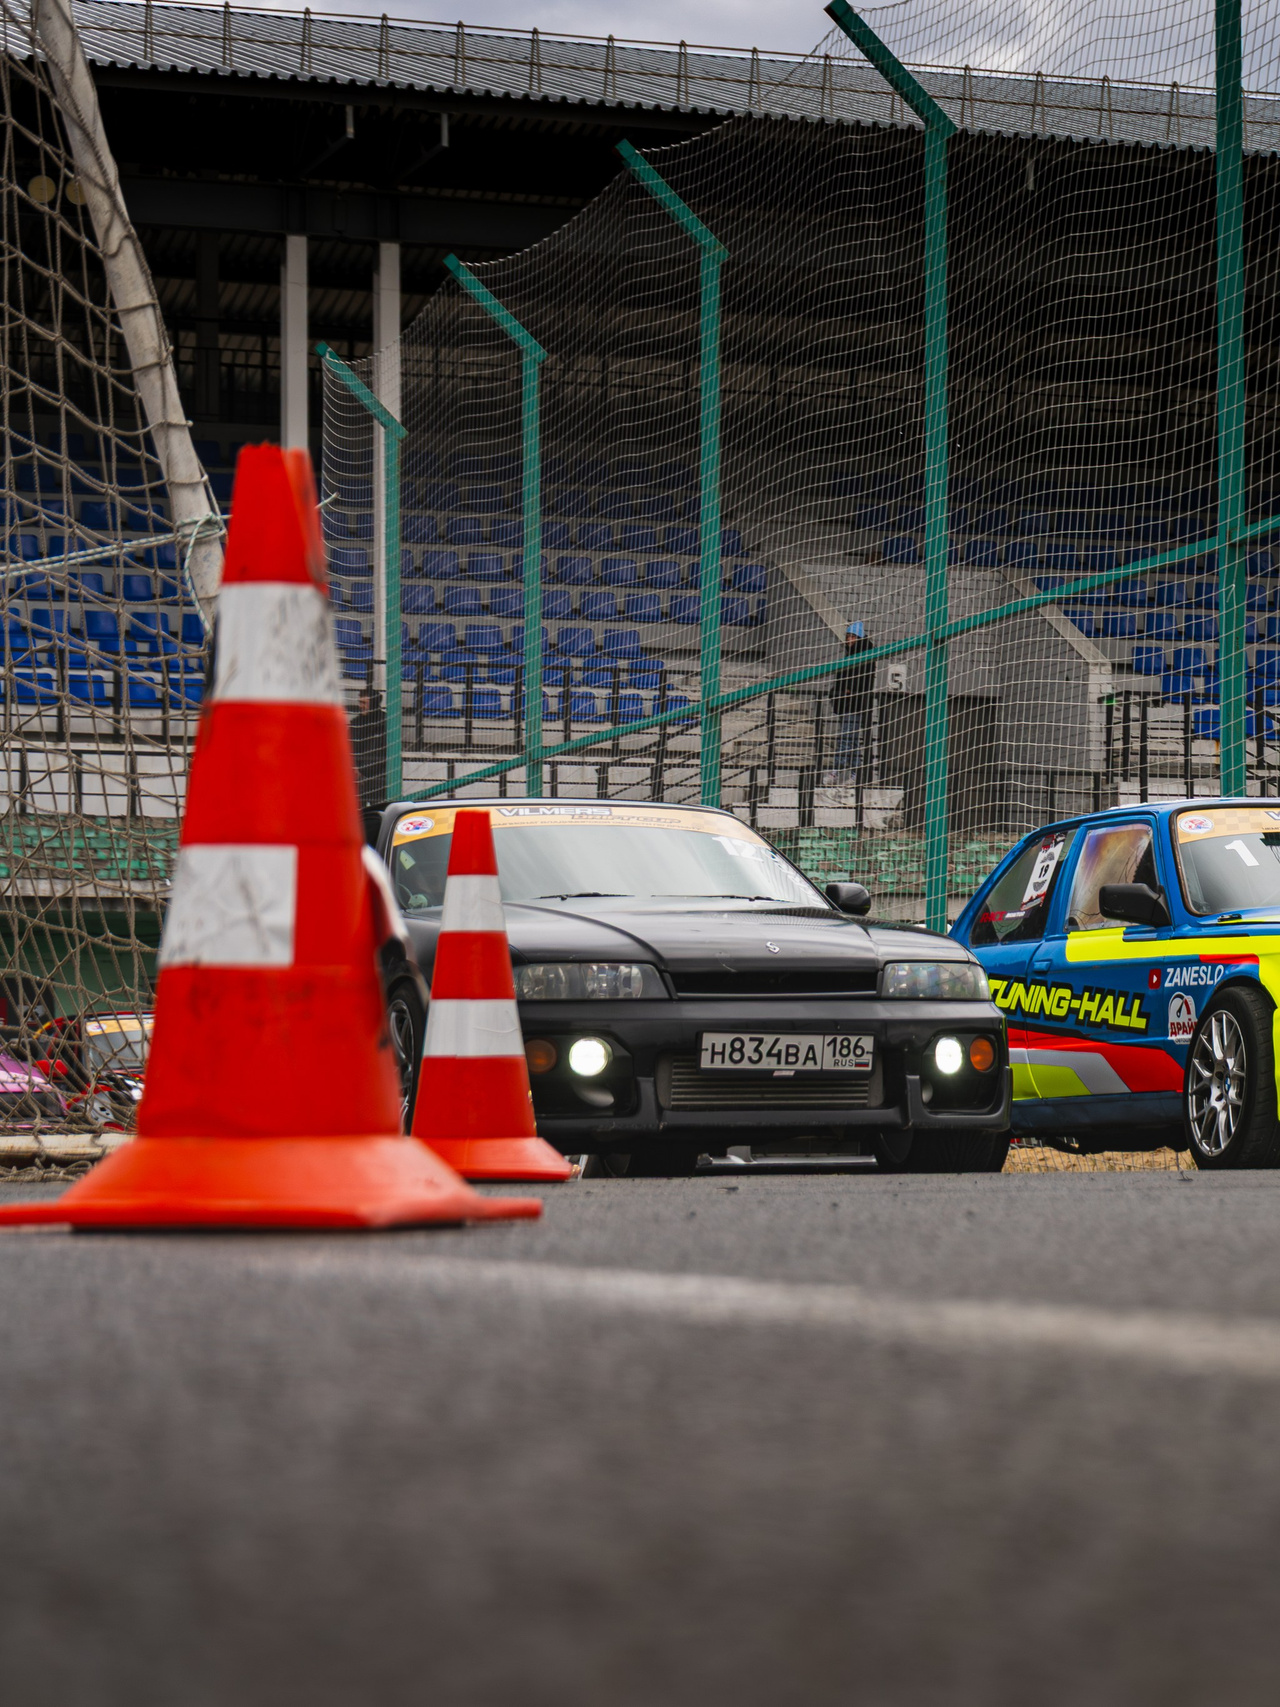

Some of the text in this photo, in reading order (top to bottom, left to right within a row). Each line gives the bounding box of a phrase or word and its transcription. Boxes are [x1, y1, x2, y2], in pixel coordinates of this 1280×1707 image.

[891, 672, 903, 691] 5
[498, 807, 612, 816] VILMERS
[712, 836, 764, 863] 12
[1224, 839, 1260, 867] 1
[1038, 864, 1050, 878] 19
[1164, 965, 1224, 988] ZANESLO
[1169, 1018, 1198, 1037] ДРАЙ
[826, 1036, 866, 1058] 186
[833, 1058, 854, 1067] RUS
